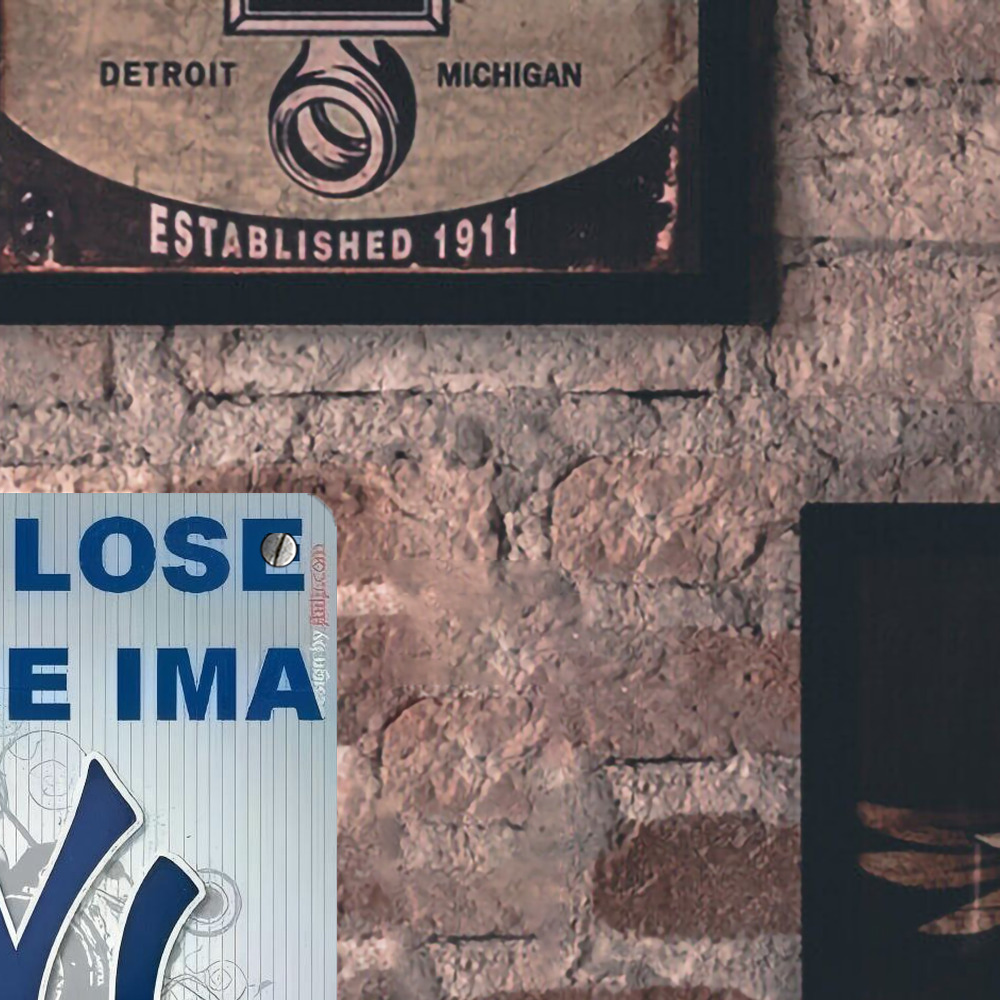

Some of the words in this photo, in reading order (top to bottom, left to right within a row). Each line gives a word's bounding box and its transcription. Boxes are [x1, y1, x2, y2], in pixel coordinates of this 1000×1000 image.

[100, 60, 238, 88] DETROIT
[437, 61, 582, 88] MICHIGAN
[149, 203, 413, 260] ESTABLISHED
[433, 207, 518, 260] 1911
[15, 516, 306, 594] LOSE
[116, 647, 325, 722] IMA
